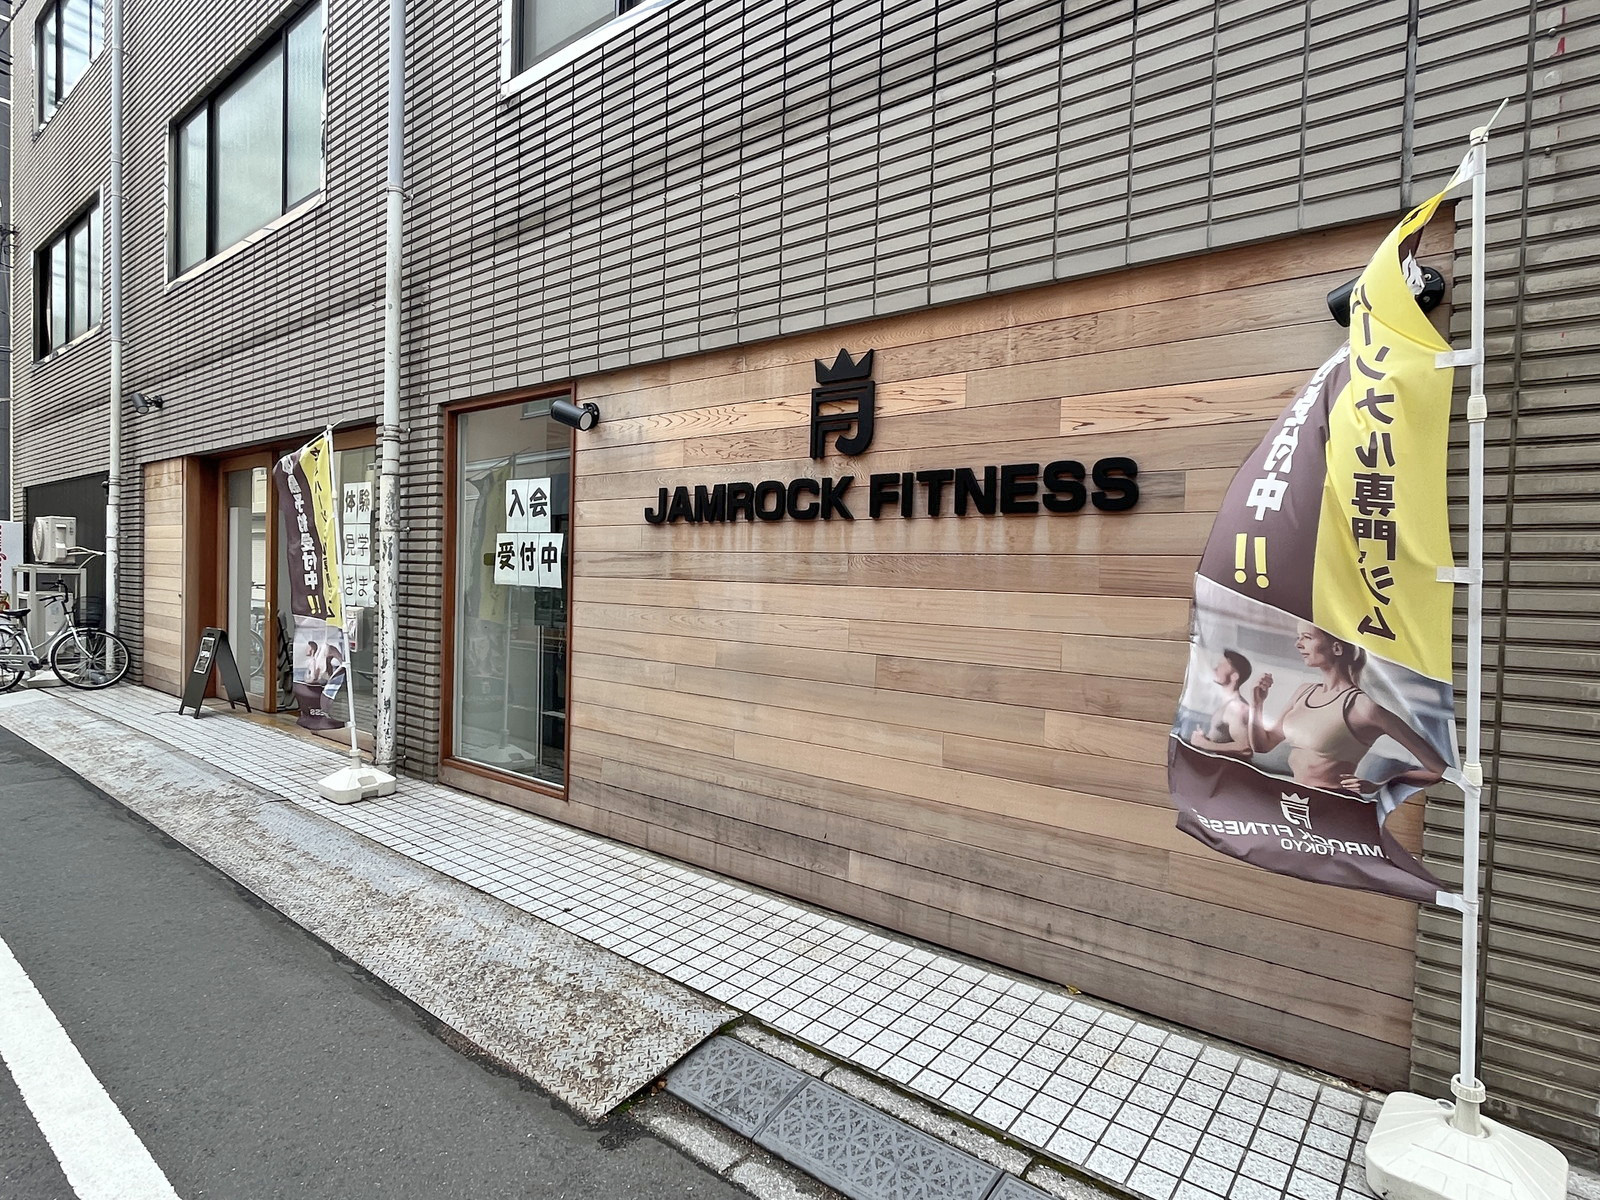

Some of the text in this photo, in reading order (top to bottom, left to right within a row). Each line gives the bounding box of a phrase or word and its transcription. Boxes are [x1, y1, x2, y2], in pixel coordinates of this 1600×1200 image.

[345, 488, 370, 513] 体験
[508, 487, 548, 517] 入会
[644, 456, 1139, 524] JAMROCK FITNESS
[345, 533, 369, 556] 見学
[497, 541, 558, 572] 受付中
